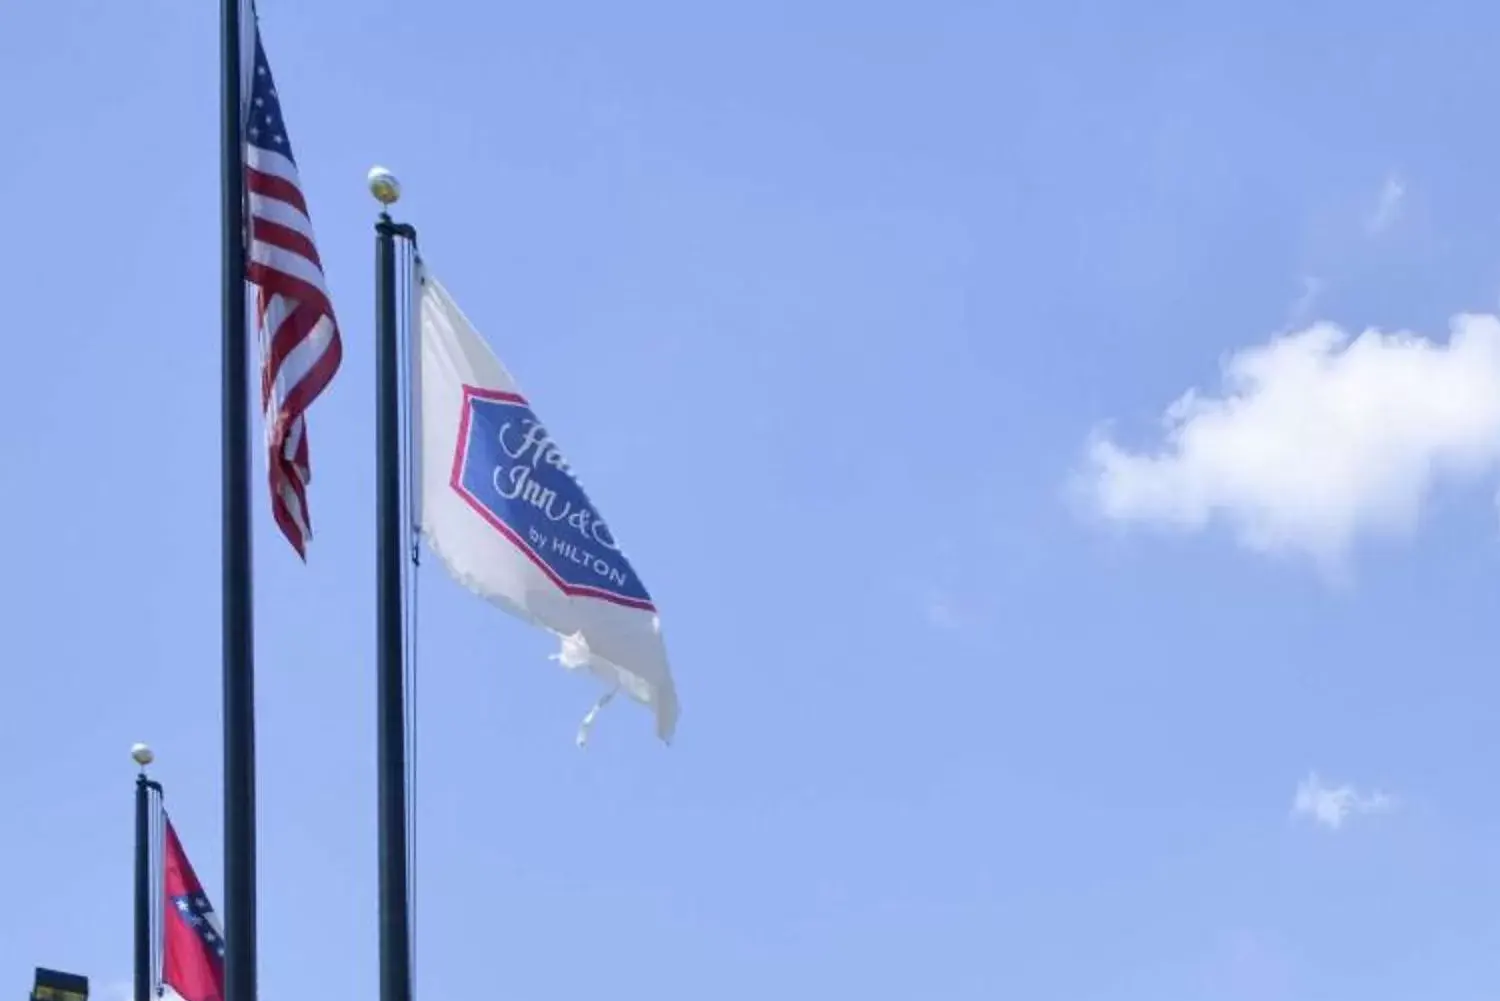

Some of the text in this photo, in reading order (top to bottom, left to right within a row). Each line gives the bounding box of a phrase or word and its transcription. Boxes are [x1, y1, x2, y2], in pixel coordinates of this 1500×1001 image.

[493, 464, 571, 521] Inn
[568, 508, 591, 539] &
[552, 536, 627, 587] HILTON
